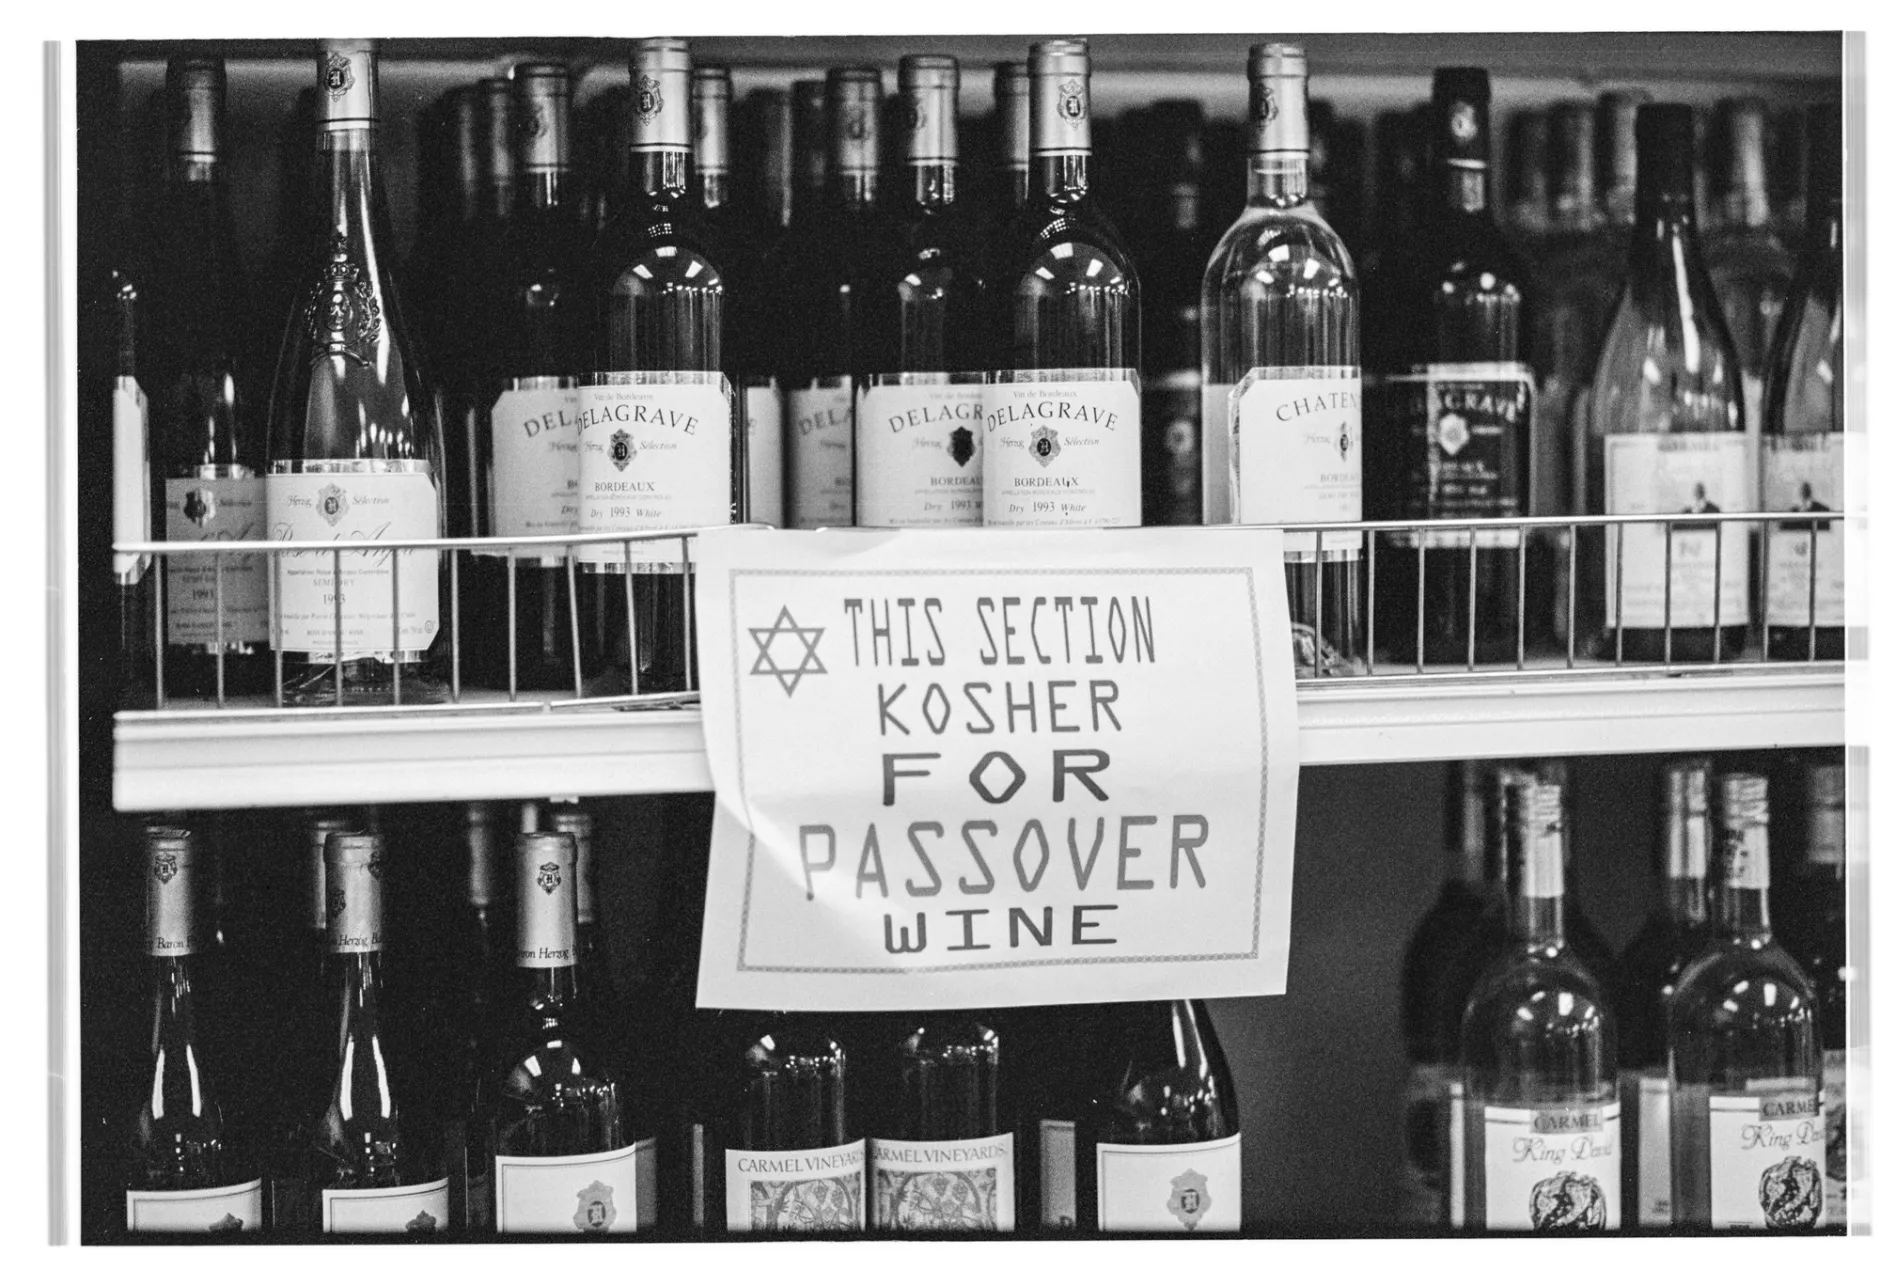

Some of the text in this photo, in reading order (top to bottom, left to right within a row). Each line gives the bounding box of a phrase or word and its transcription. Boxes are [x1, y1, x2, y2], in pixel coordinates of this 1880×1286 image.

[1039, 388, 1078, 398] Bordeaux
[576, 404, 699, 436] DELAGRAVE
[987, 401, 1119, 433] DELAGRAVE
[594, 481, 655, 492] BORDEAUX
[1014, 477, 1079, 487] BORDEAUX
[590, 506, 662, 519] Dry 1993 White
[1009, 501, 1086, 513] Dry 1993 White
[323, 594, 346, 606] 193
[844, 595, 1156, 666] THIS SECTION
[877, 679, 1122, 736] KOSHER
[882, 748, 1111, 806] FOR
[799, 813, 1210, 902] PASSOVER
[883, 904, 1120, 954] WINE
[538, 946, 570, 960] Herzog
[1534, 1113, 1601, 1131] CARMEL
[1741, 1123, 1793, 1151] King
[924, 1143, 1007, 1162] VINEYARDS
[1512, 1136, 1566, 1165] King
[738, 1157, 804, 1173] CARMEL
